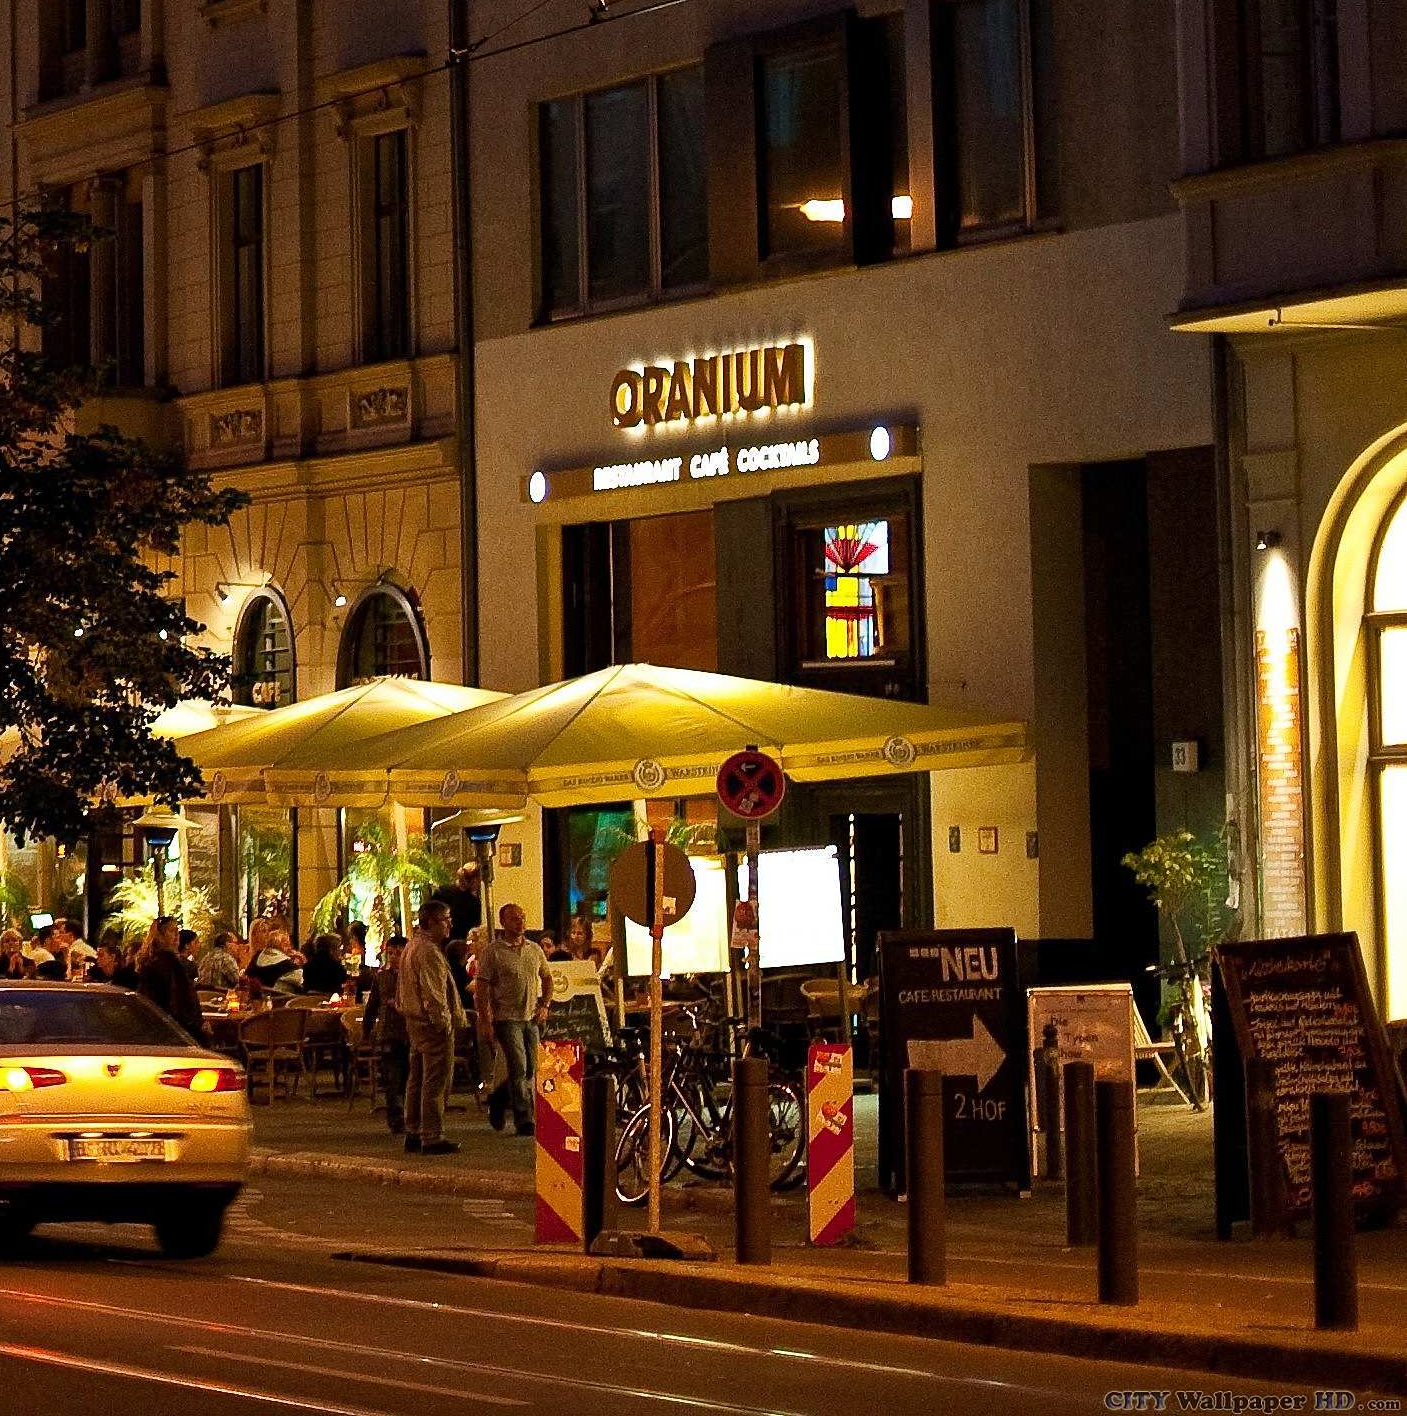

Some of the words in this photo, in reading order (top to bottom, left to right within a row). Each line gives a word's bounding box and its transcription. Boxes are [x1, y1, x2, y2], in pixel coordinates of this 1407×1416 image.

[610, 342, 810, 429] ORANIUM
[737, 438, 820, 472] COCKTAILS
[940, 946, 999, 982] NEU
